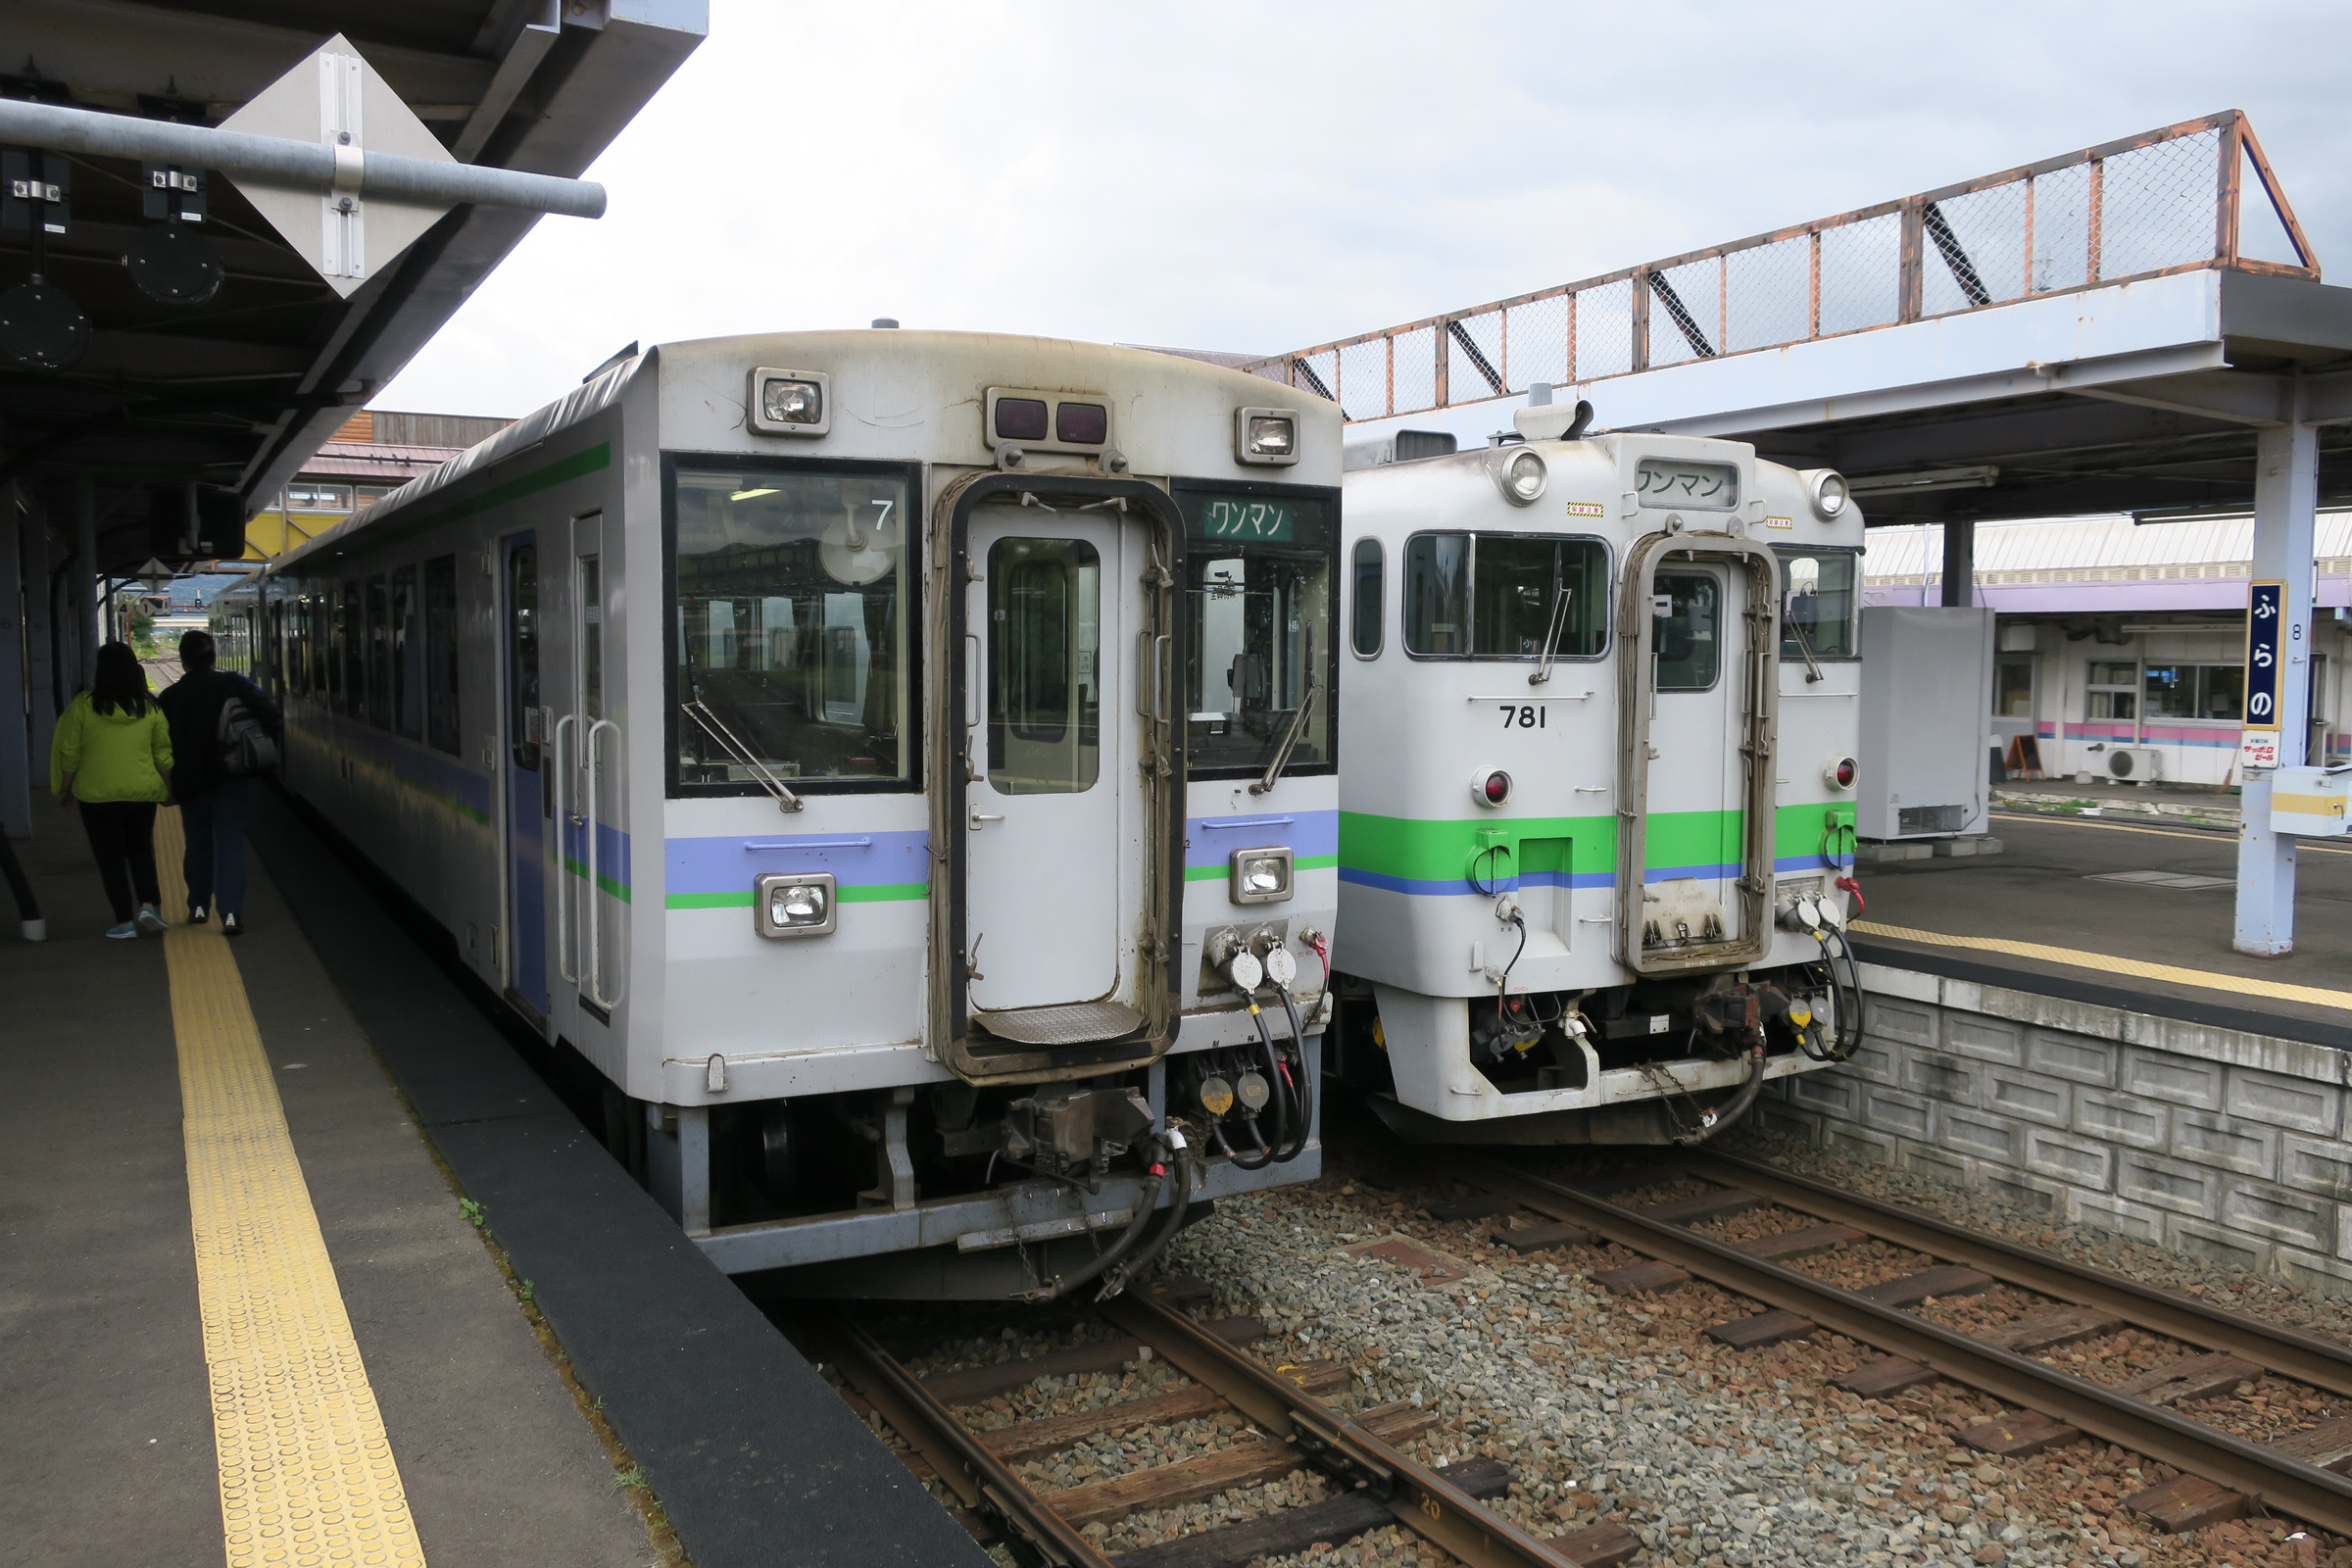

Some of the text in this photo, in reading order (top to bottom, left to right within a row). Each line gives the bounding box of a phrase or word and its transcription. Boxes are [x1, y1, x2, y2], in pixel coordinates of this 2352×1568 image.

[871, 499, 894, 530] 7
[1212, 502, 1283, 536] ワンマン
[119, 604, 128, 612] 4
[143, 604, 148, 613] 1
[2292, 623, 2302, 641] 8
[2250, 594, 2278, 716] ふらの
[1499, 706, 1545, 729] 781
